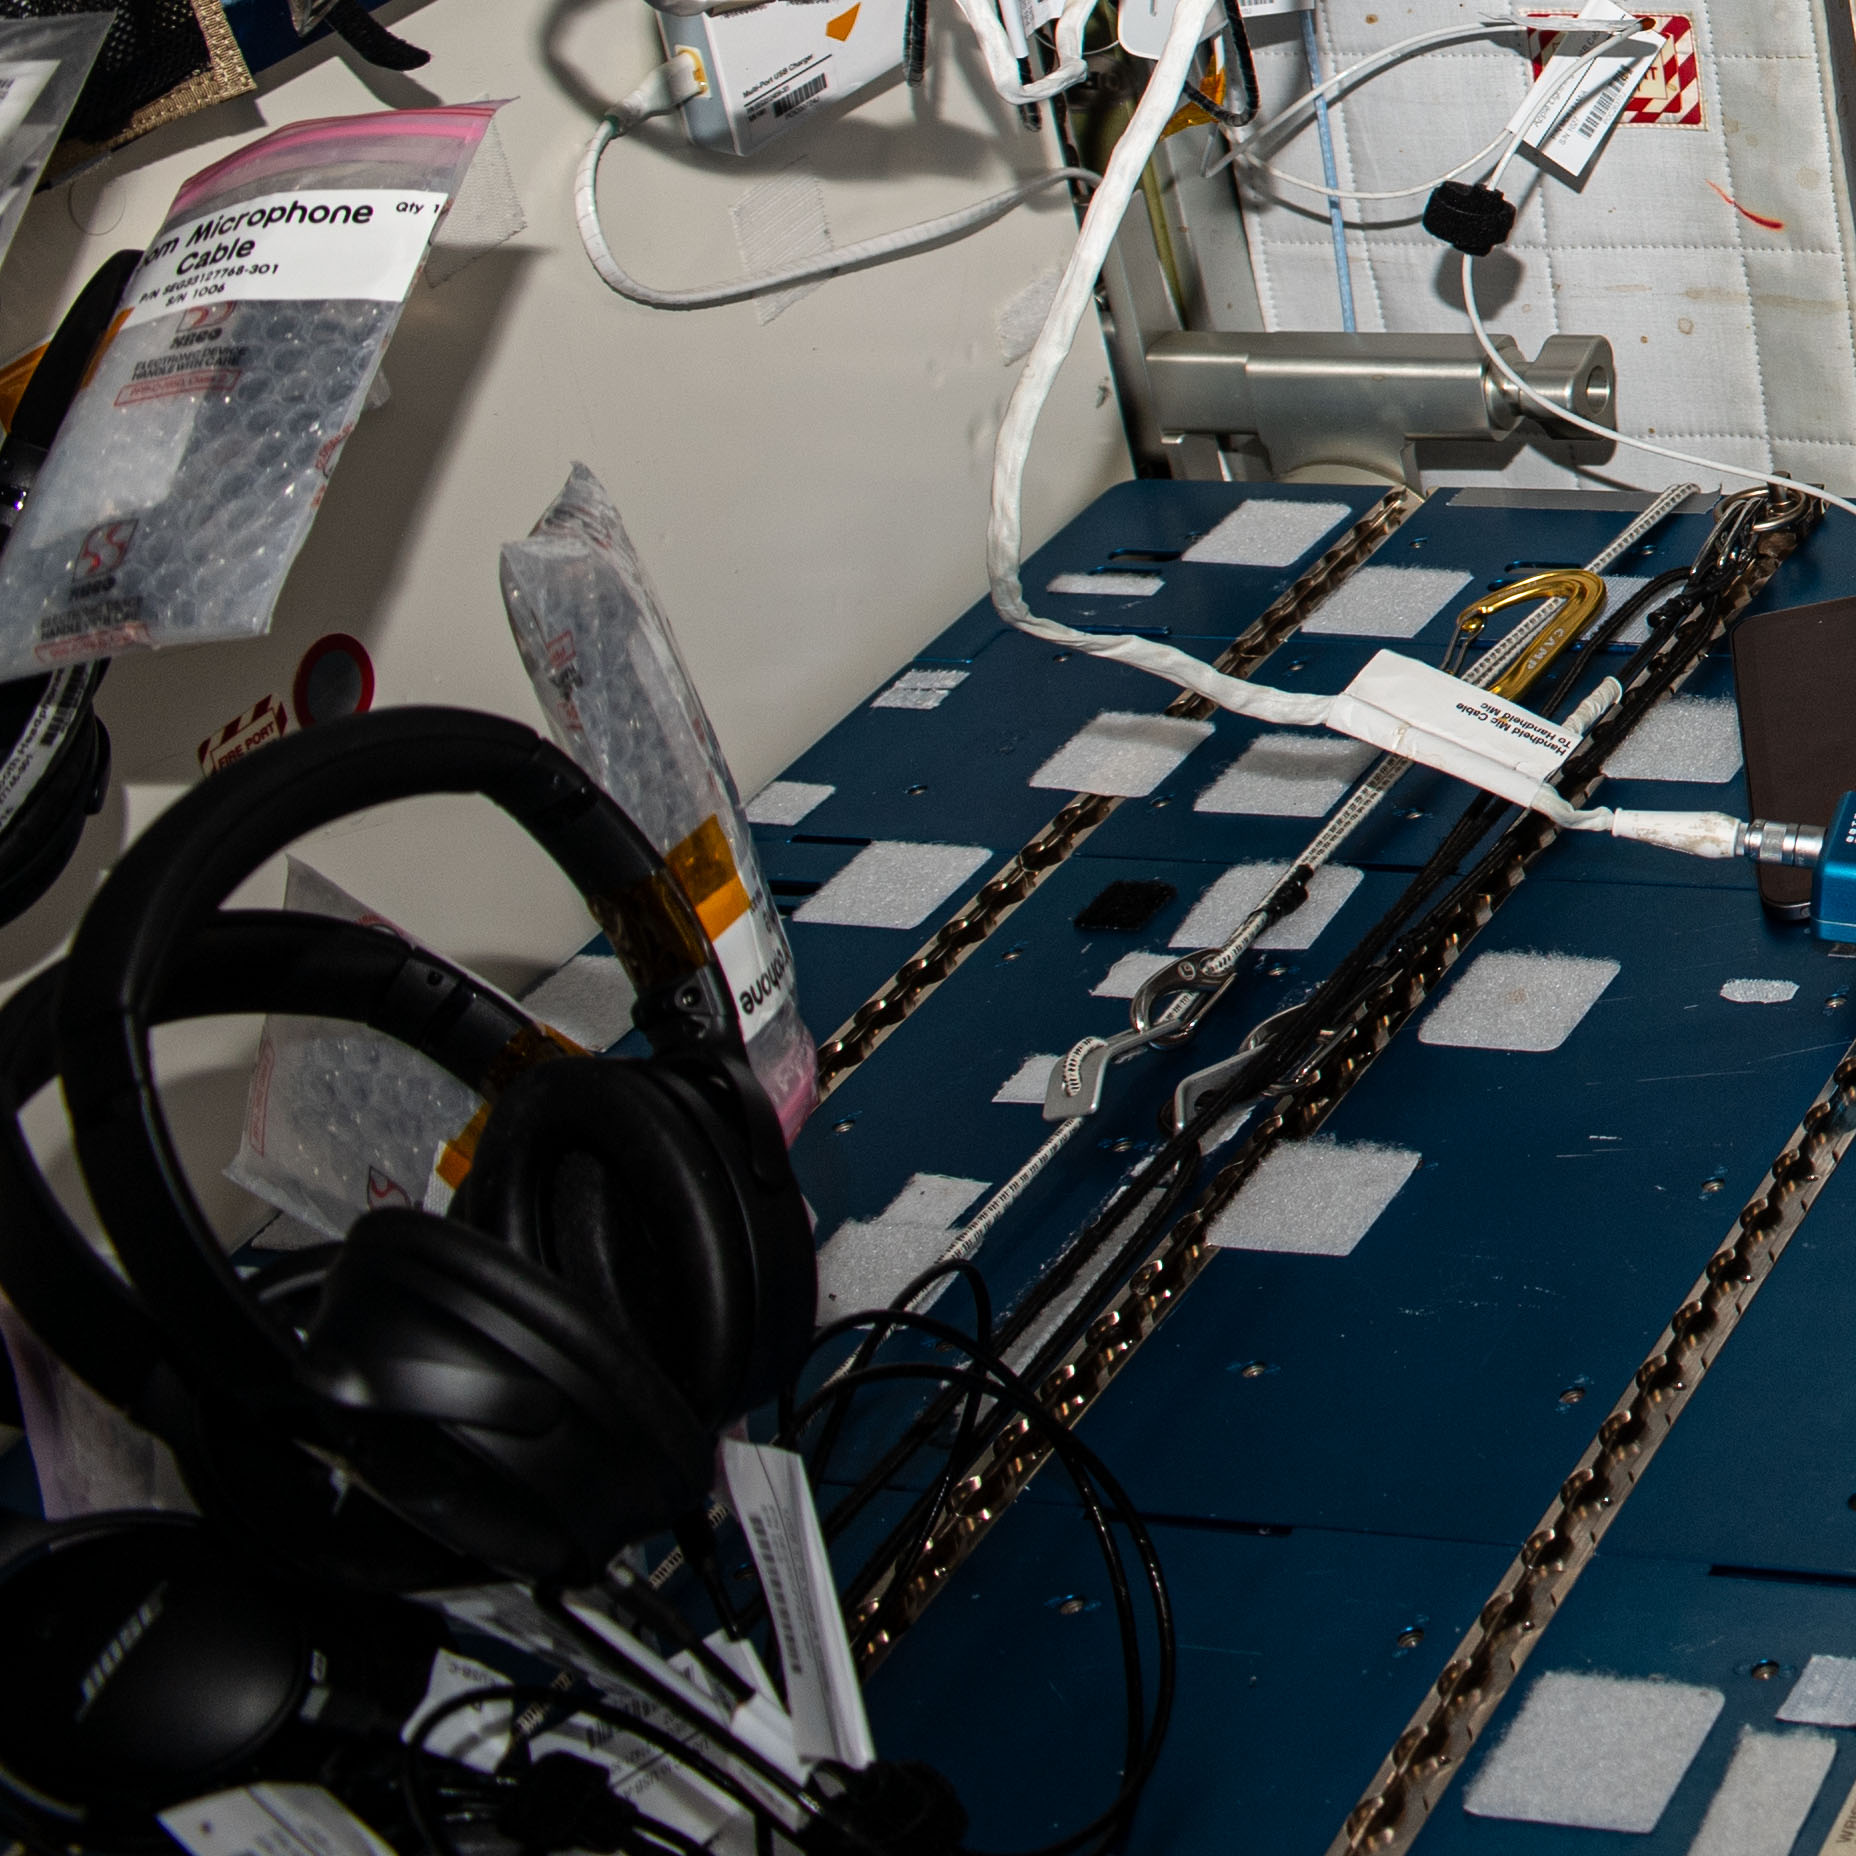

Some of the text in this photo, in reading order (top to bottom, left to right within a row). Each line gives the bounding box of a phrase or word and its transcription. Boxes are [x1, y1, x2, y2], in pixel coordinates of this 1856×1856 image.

[774, 67, 788, 81] USB
[788, 53, 813, 72] Charger
[185, 200, 374, 247] Microphone
[396, 201, 424, 215] Qty
[176, 237, 255, 275] Cable
[166, 283, 226, 307] S/N 1006
[1527, 627, 1566, 670] CAMP
[218, 721, 275, 769] FIRE PORT
[1456, 703, 1568, 757] Handheld Mic Cable
[1480, 702, 1573, 749] To Handheld Mic
